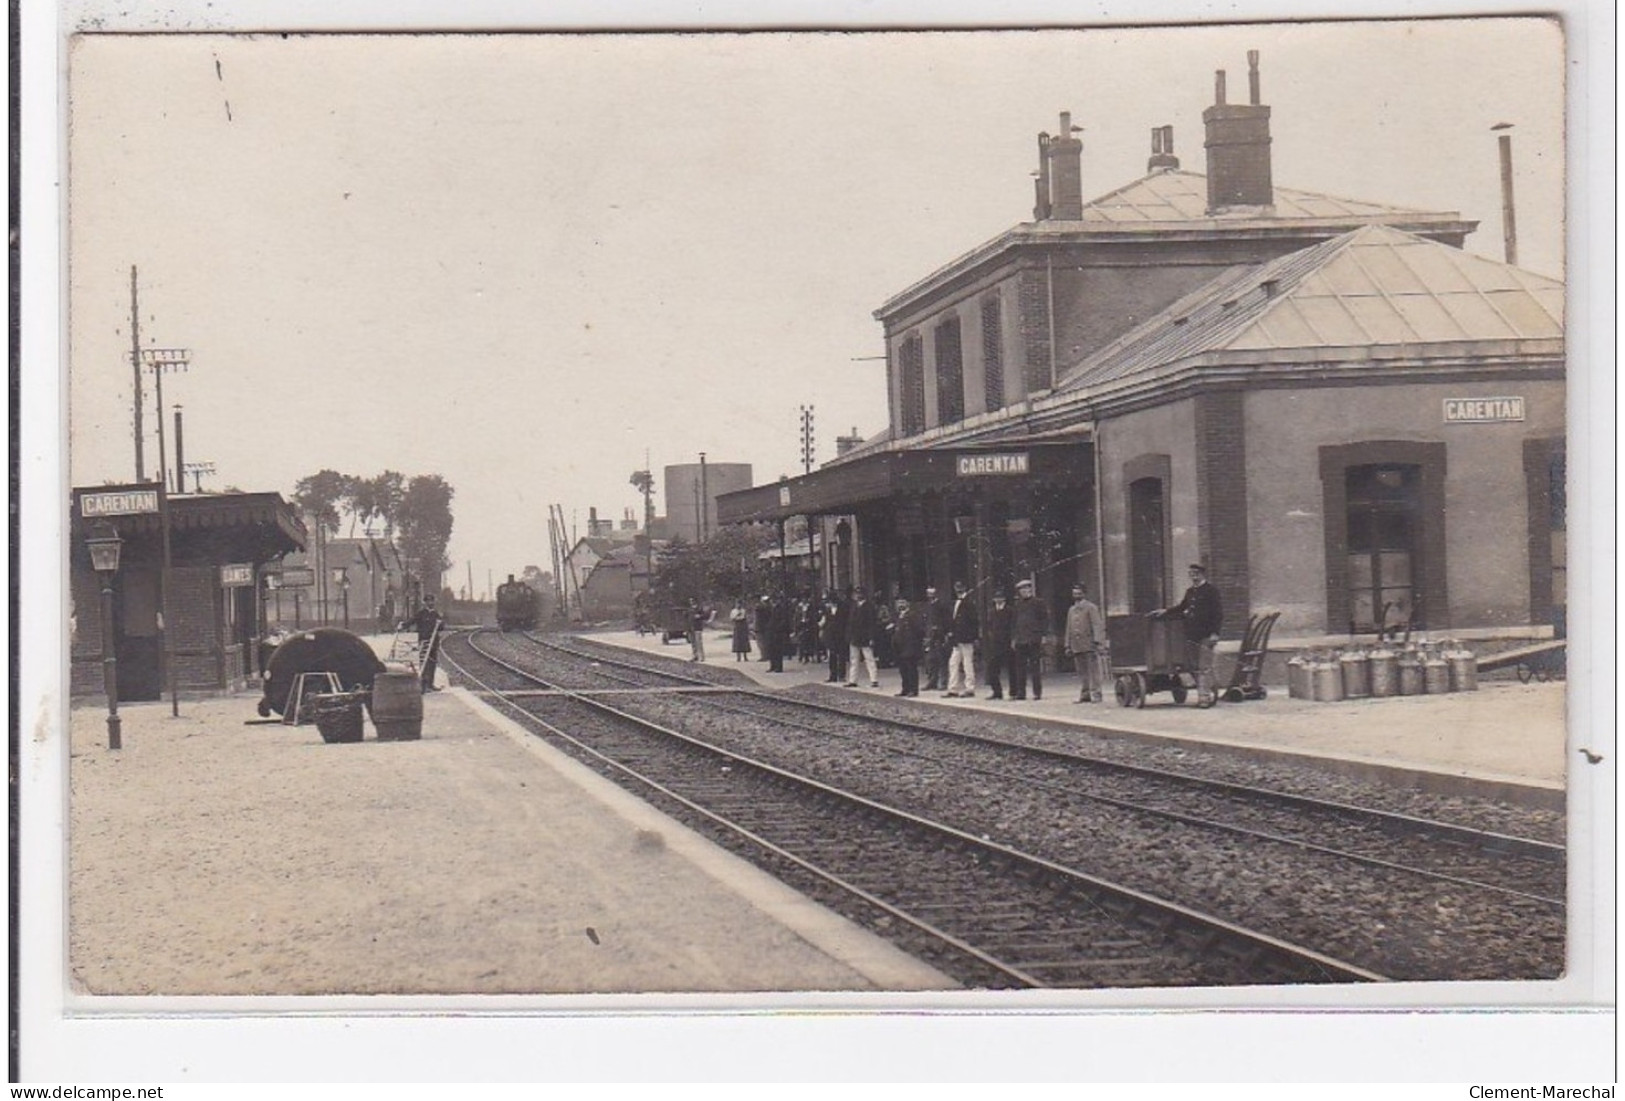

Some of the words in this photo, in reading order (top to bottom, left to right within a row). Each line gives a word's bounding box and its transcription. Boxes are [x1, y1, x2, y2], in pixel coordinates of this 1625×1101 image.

[1447, 400, 1520, 419] CARENTAN
[960, 456, 1026, 473] CARENTAN
[85, 494, 154, 513] CARENTAN
